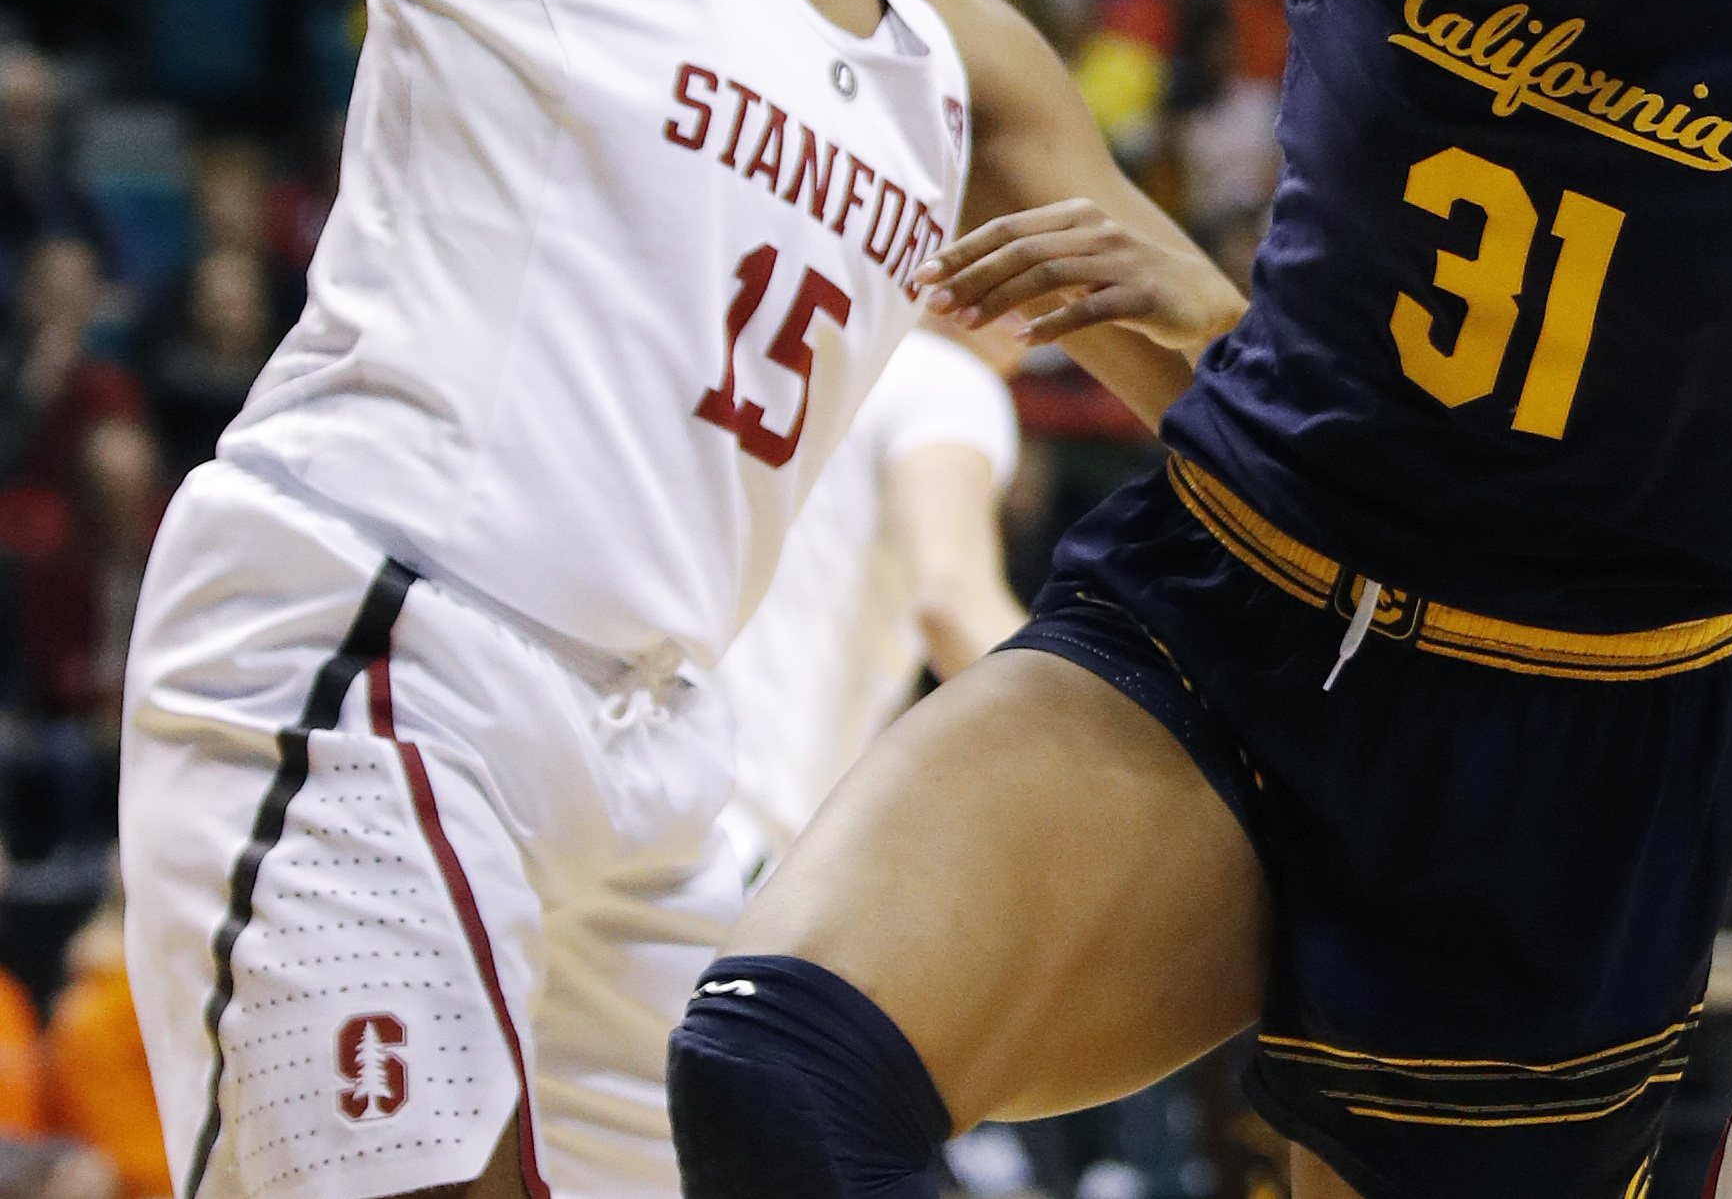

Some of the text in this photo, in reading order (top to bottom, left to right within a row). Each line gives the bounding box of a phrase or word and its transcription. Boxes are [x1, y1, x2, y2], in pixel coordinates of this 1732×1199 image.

[664, 63, 944, 302] STANFORD
[1389, 146, 1626, 440] 31
[695, 244, 851, 468] 15
